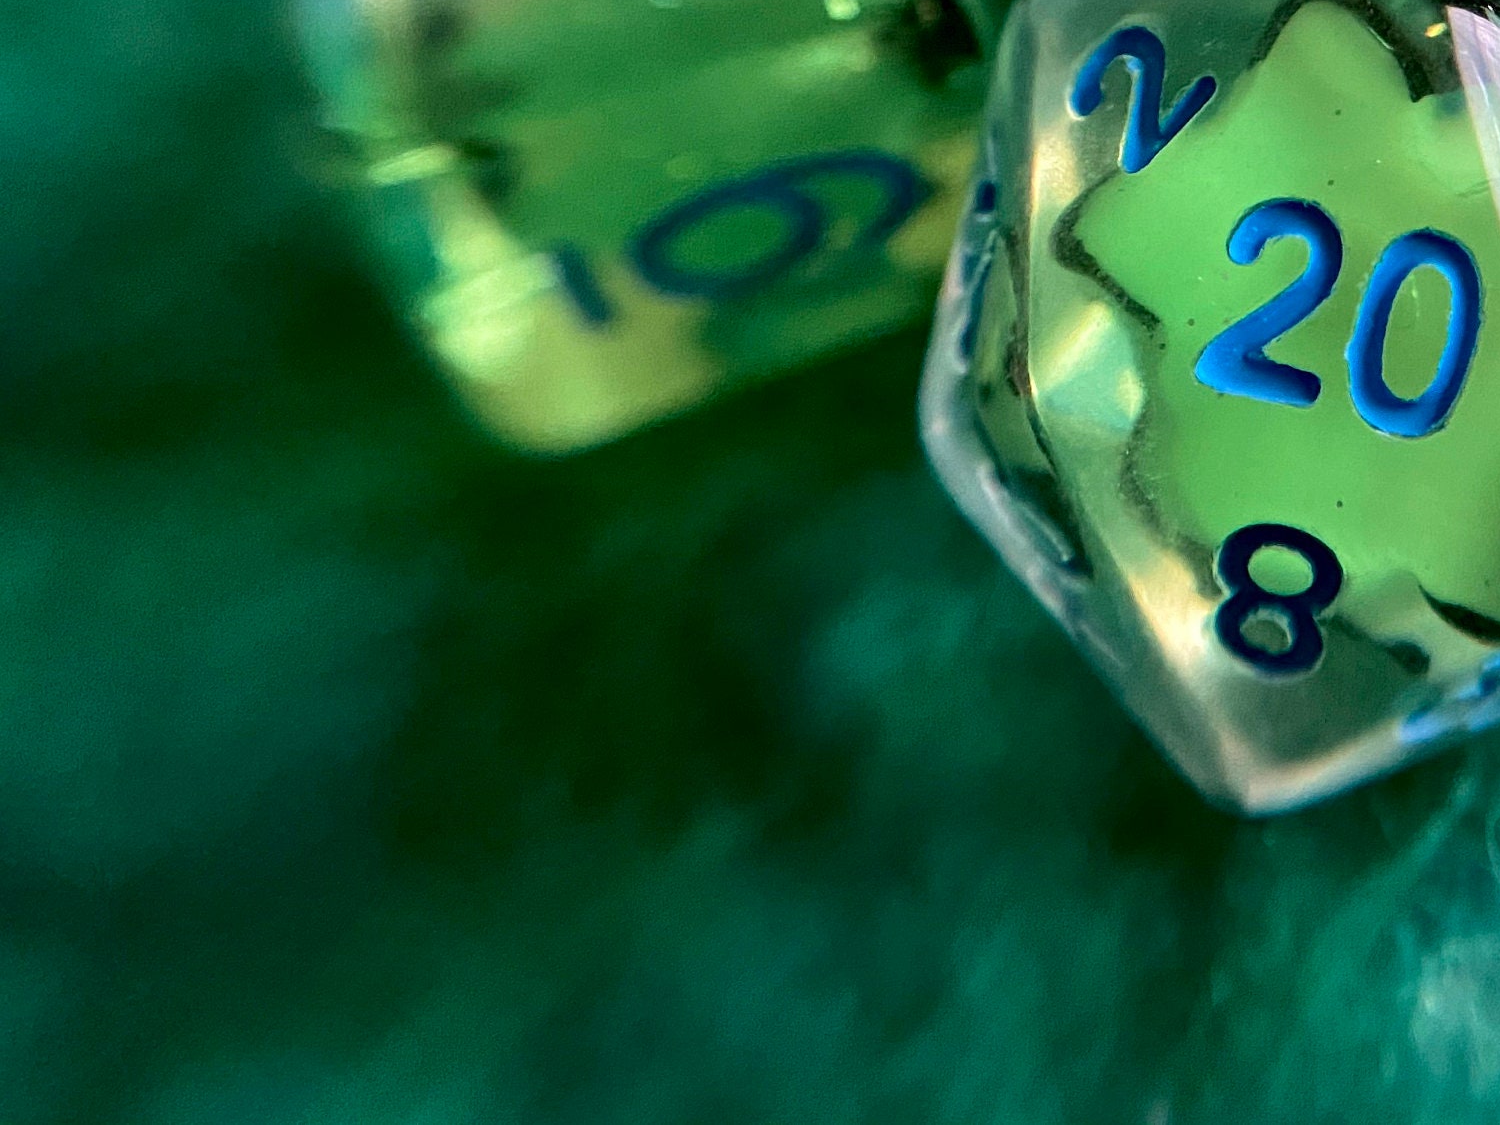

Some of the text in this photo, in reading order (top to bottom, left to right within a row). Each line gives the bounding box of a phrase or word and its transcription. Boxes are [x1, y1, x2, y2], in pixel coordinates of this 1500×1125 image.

[1068, 23, 1217, 174] 2
[1193, 195, 1484, 439] 20
[1213, 521, 1345, 677] 8
